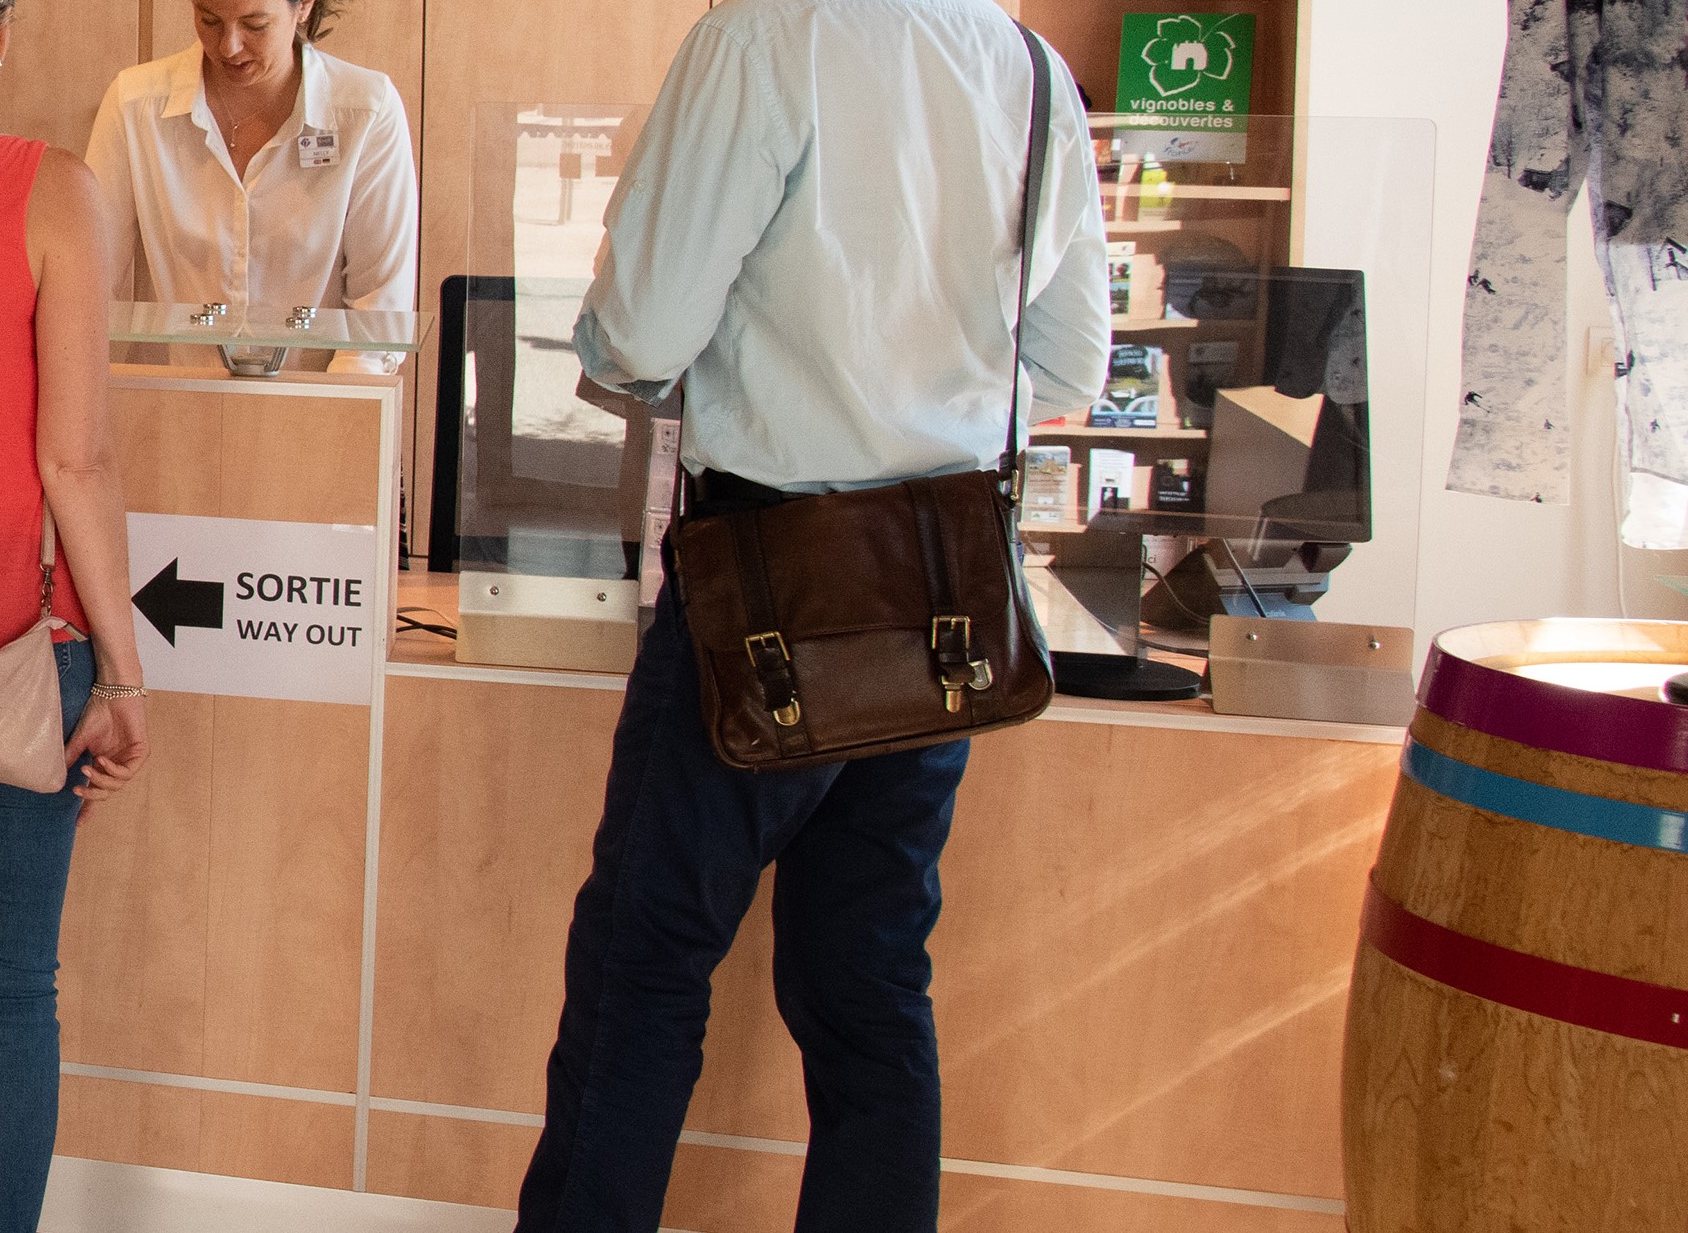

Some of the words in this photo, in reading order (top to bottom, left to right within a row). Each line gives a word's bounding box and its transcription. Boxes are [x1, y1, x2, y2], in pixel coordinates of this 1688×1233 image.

[1130, 97, 1216, 113] vignobles
[1222, 99, 1235, 112] &
[235, 571, 362, 607] SORTIE
[236, 618, 299, 643] WAY
[305, 624, 363, 647] OUT
